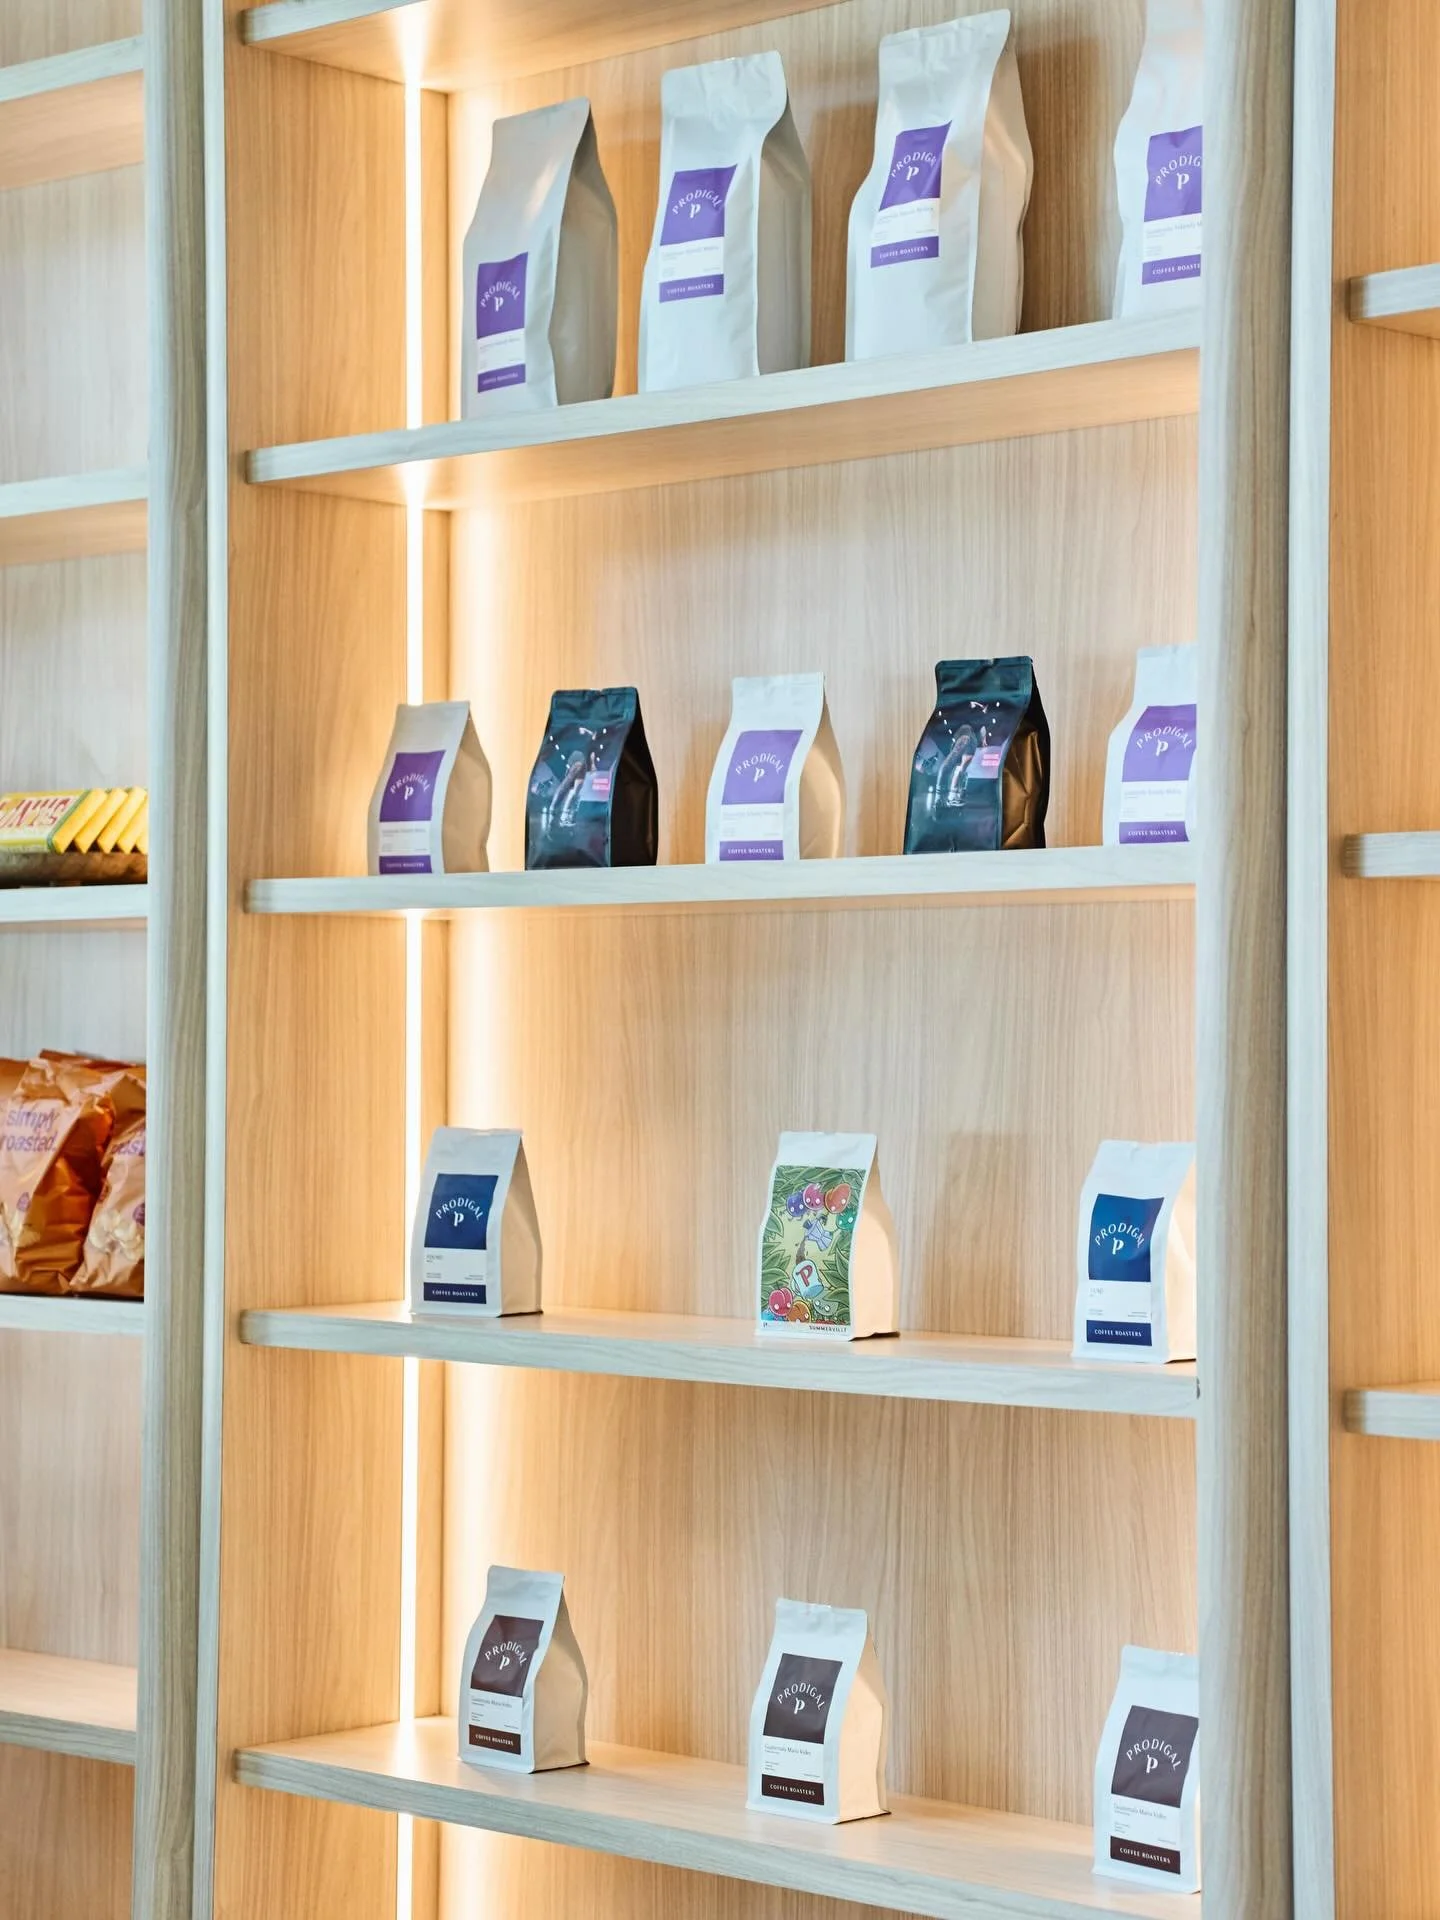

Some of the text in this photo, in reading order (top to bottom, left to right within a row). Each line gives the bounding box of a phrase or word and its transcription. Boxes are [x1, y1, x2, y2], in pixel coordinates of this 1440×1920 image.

[891, 151, 938, 178] PRODIGA
[1155, 154, 1202, 185] PRODIG
[672, 189, 723, 215] PRODIGAL
[1177, 262, 1201, 272] ROASTE
[481, 280, 521, 308] PRODIGAL
[1136, 725, 1192, 750] PRODIGAL
[735, 752, 784, 775] PRODIGAL
[390, 772, 431, 794] PRODIGAL
[435, 1197, 484, 1221] PRODIGAL
[796, 1265, 813, 1287] P
[1094, 1328, 1142, 1338] COFFEE ROASTERS
[484, 1641, 528, 1668] PRODIGAL
[777, 1682, 826, 1711] PRODIGAL
[1126, 1738, 1182, 1771] PRODIGAL
[769, 1783, 816, 1796] COFFEE ROASTERS
[1119, 1847, 1172, 1864] COFFEE ROASTERS
